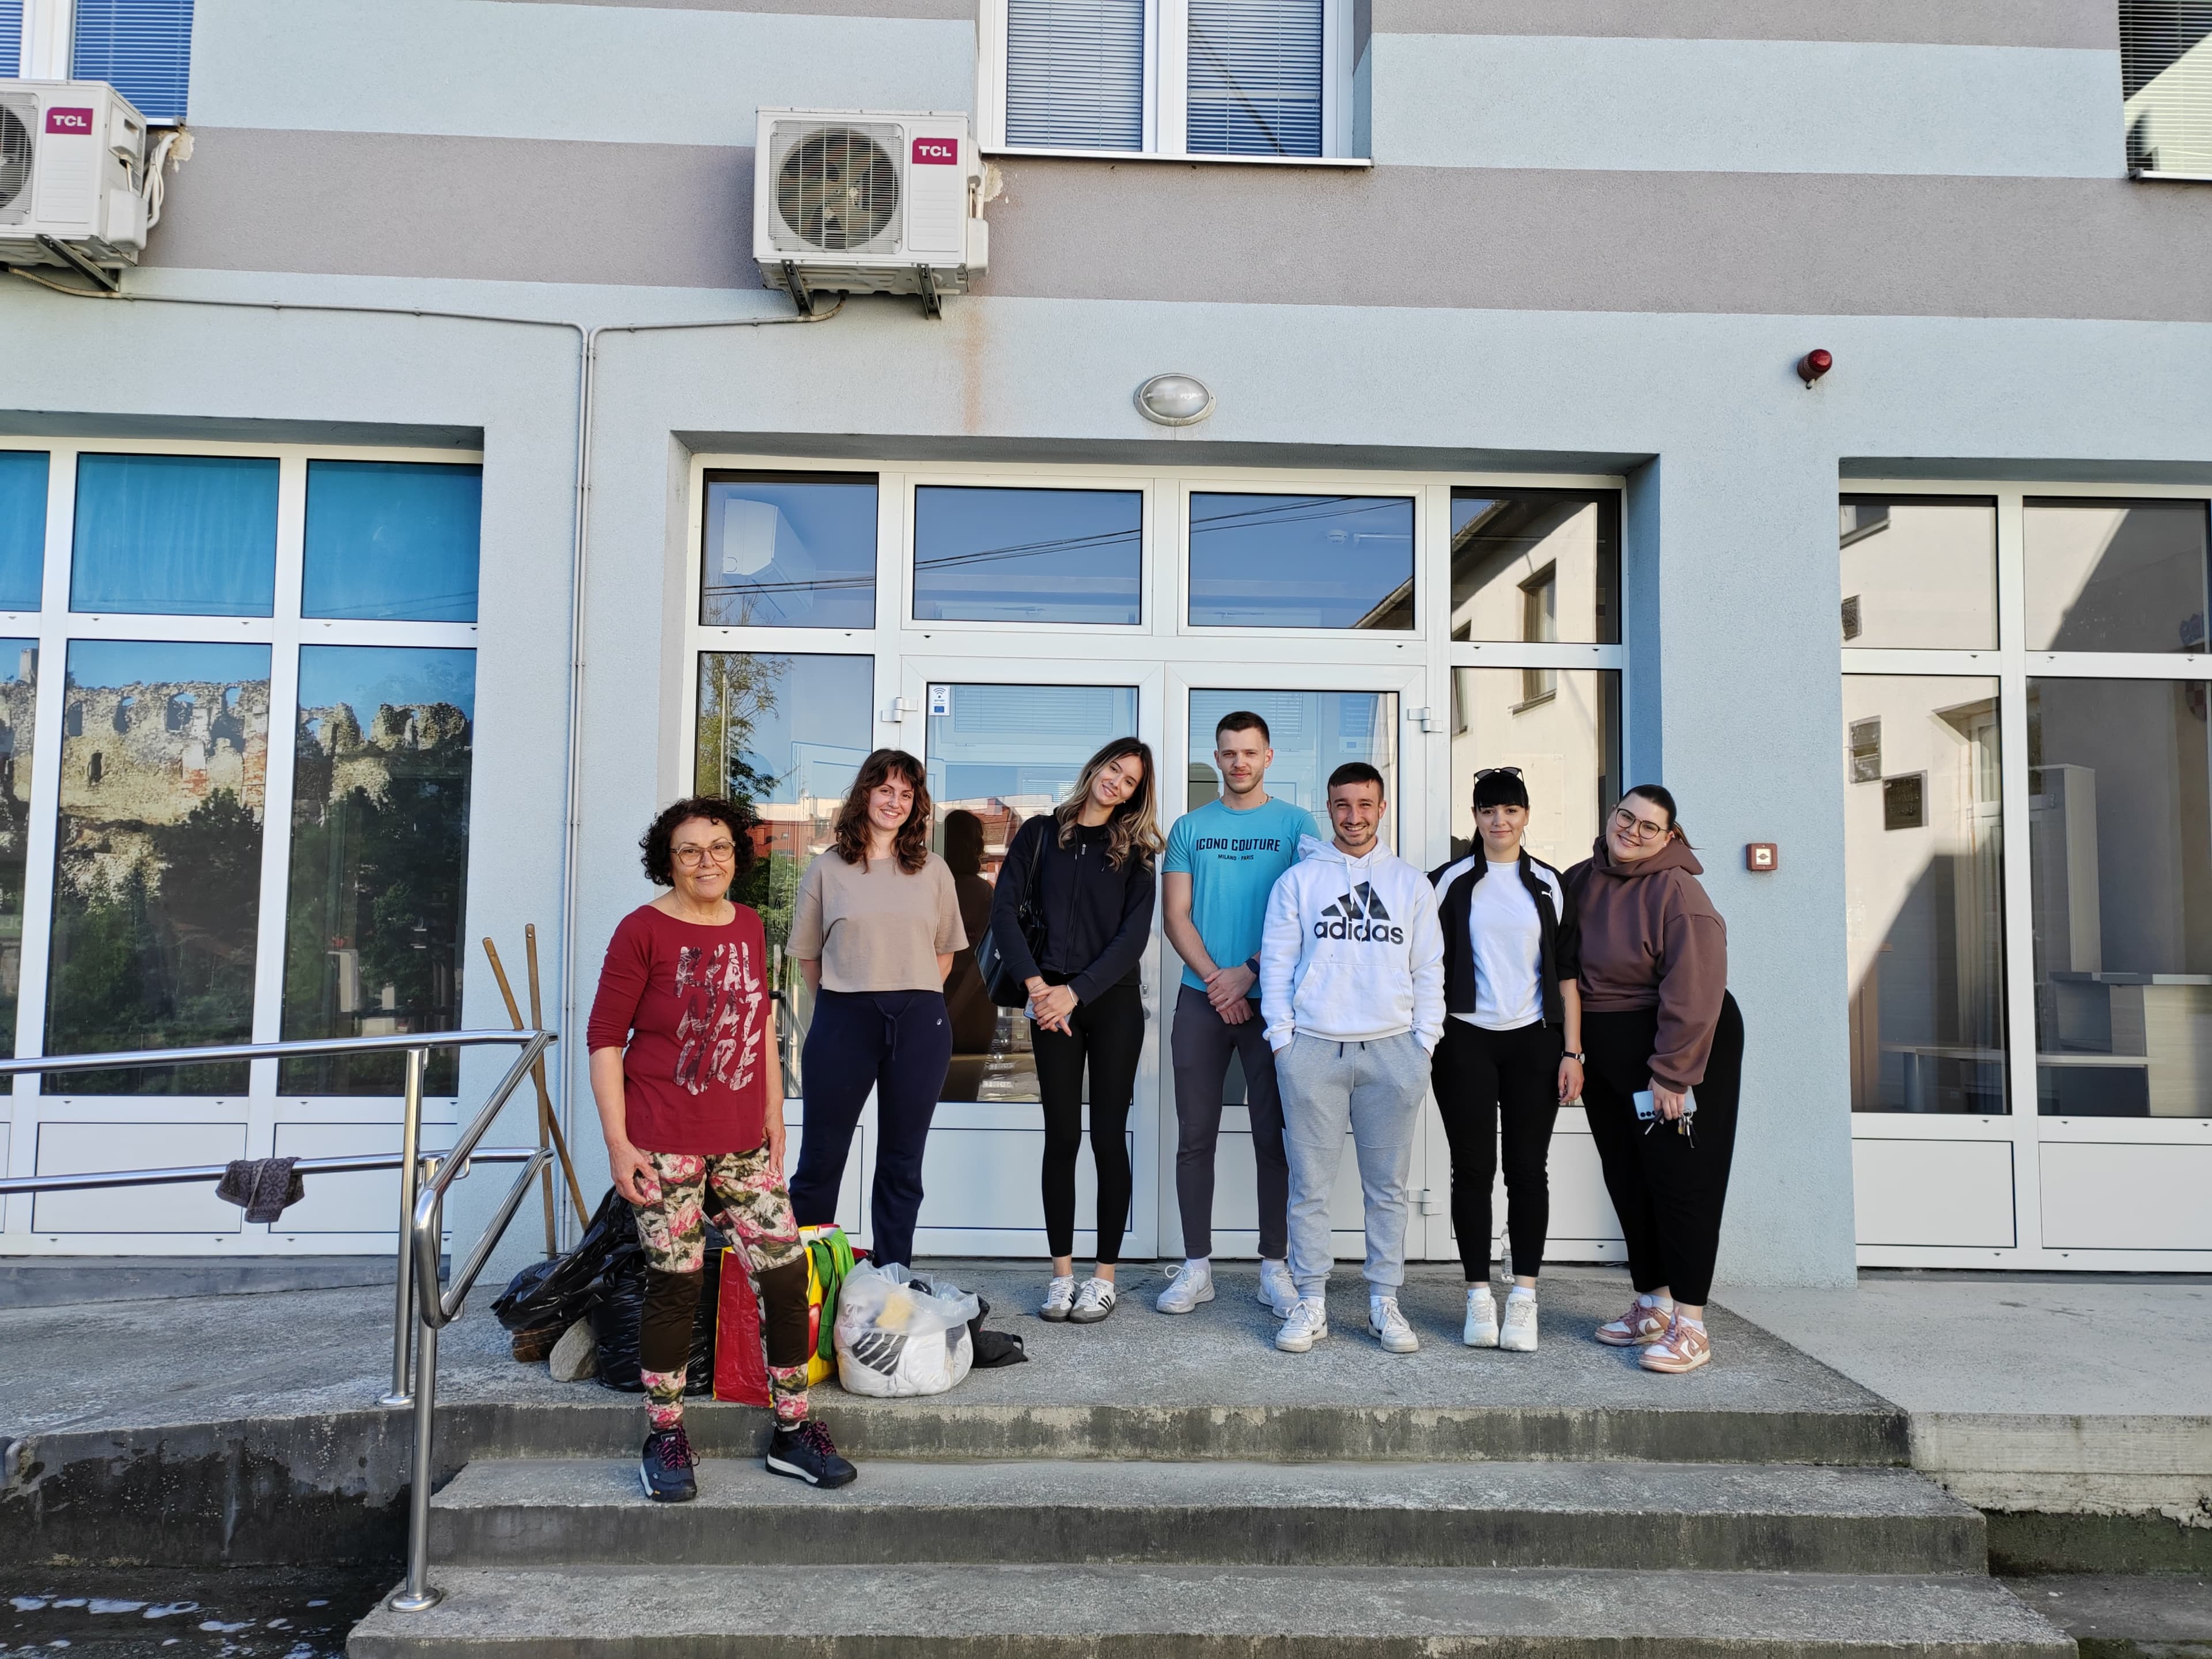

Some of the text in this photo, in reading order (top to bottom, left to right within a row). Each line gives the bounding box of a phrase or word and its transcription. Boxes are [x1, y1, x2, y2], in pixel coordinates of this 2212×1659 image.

[52, 115, 87, 127] TCL
[918, 145, 952, 157] TCL
[1196, 838, 1281, 852] ICONO COUTURE
[1314, 916, 1404, 945] adidas
